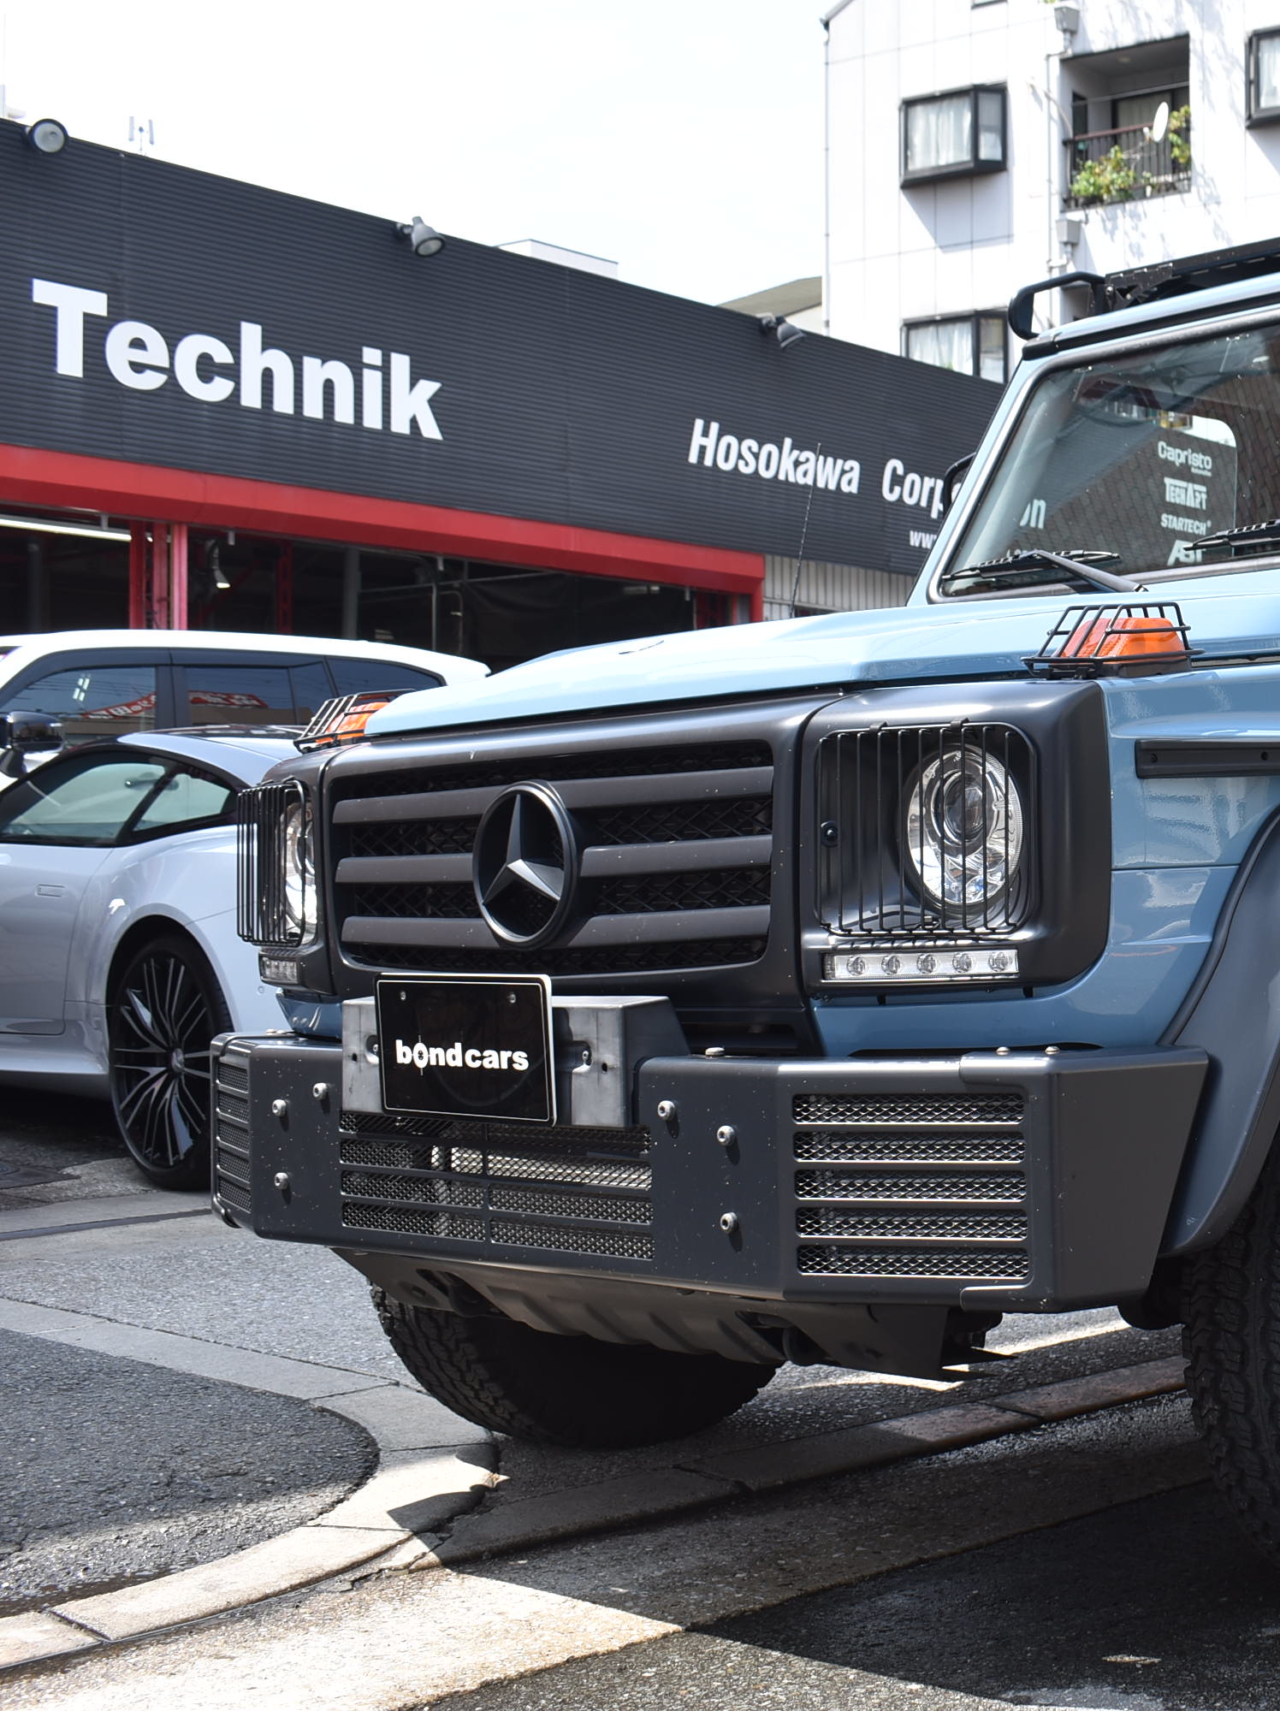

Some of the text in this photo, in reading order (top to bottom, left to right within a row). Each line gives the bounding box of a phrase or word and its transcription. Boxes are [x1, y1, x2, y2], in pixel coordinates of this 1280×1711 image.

[32, 278, 444, 441] Technik
[688, 418, 860, 494] Hosokawa
[1158, 440, 1212, 470] Capristo
[395, 1039, 529, 1071] bondcars
